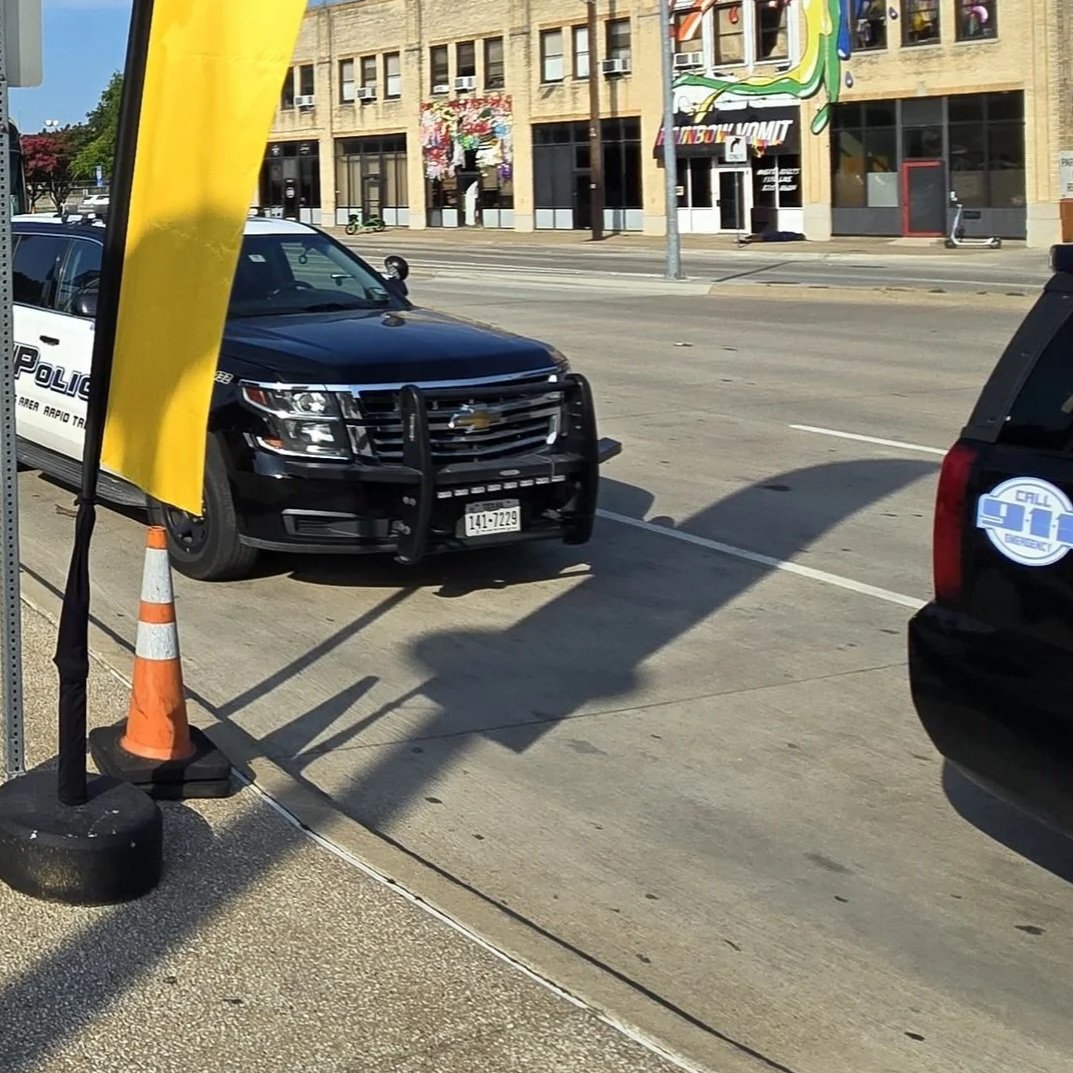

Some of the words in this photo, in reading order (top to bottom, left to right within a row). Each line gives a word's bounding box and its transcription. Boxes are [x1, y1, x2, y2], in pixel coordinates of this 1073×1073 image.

[18, 396, 40, 412] AREA
[43, 406, 70, 424] RAPID
[1016, 490, 1051, 508] CALL
